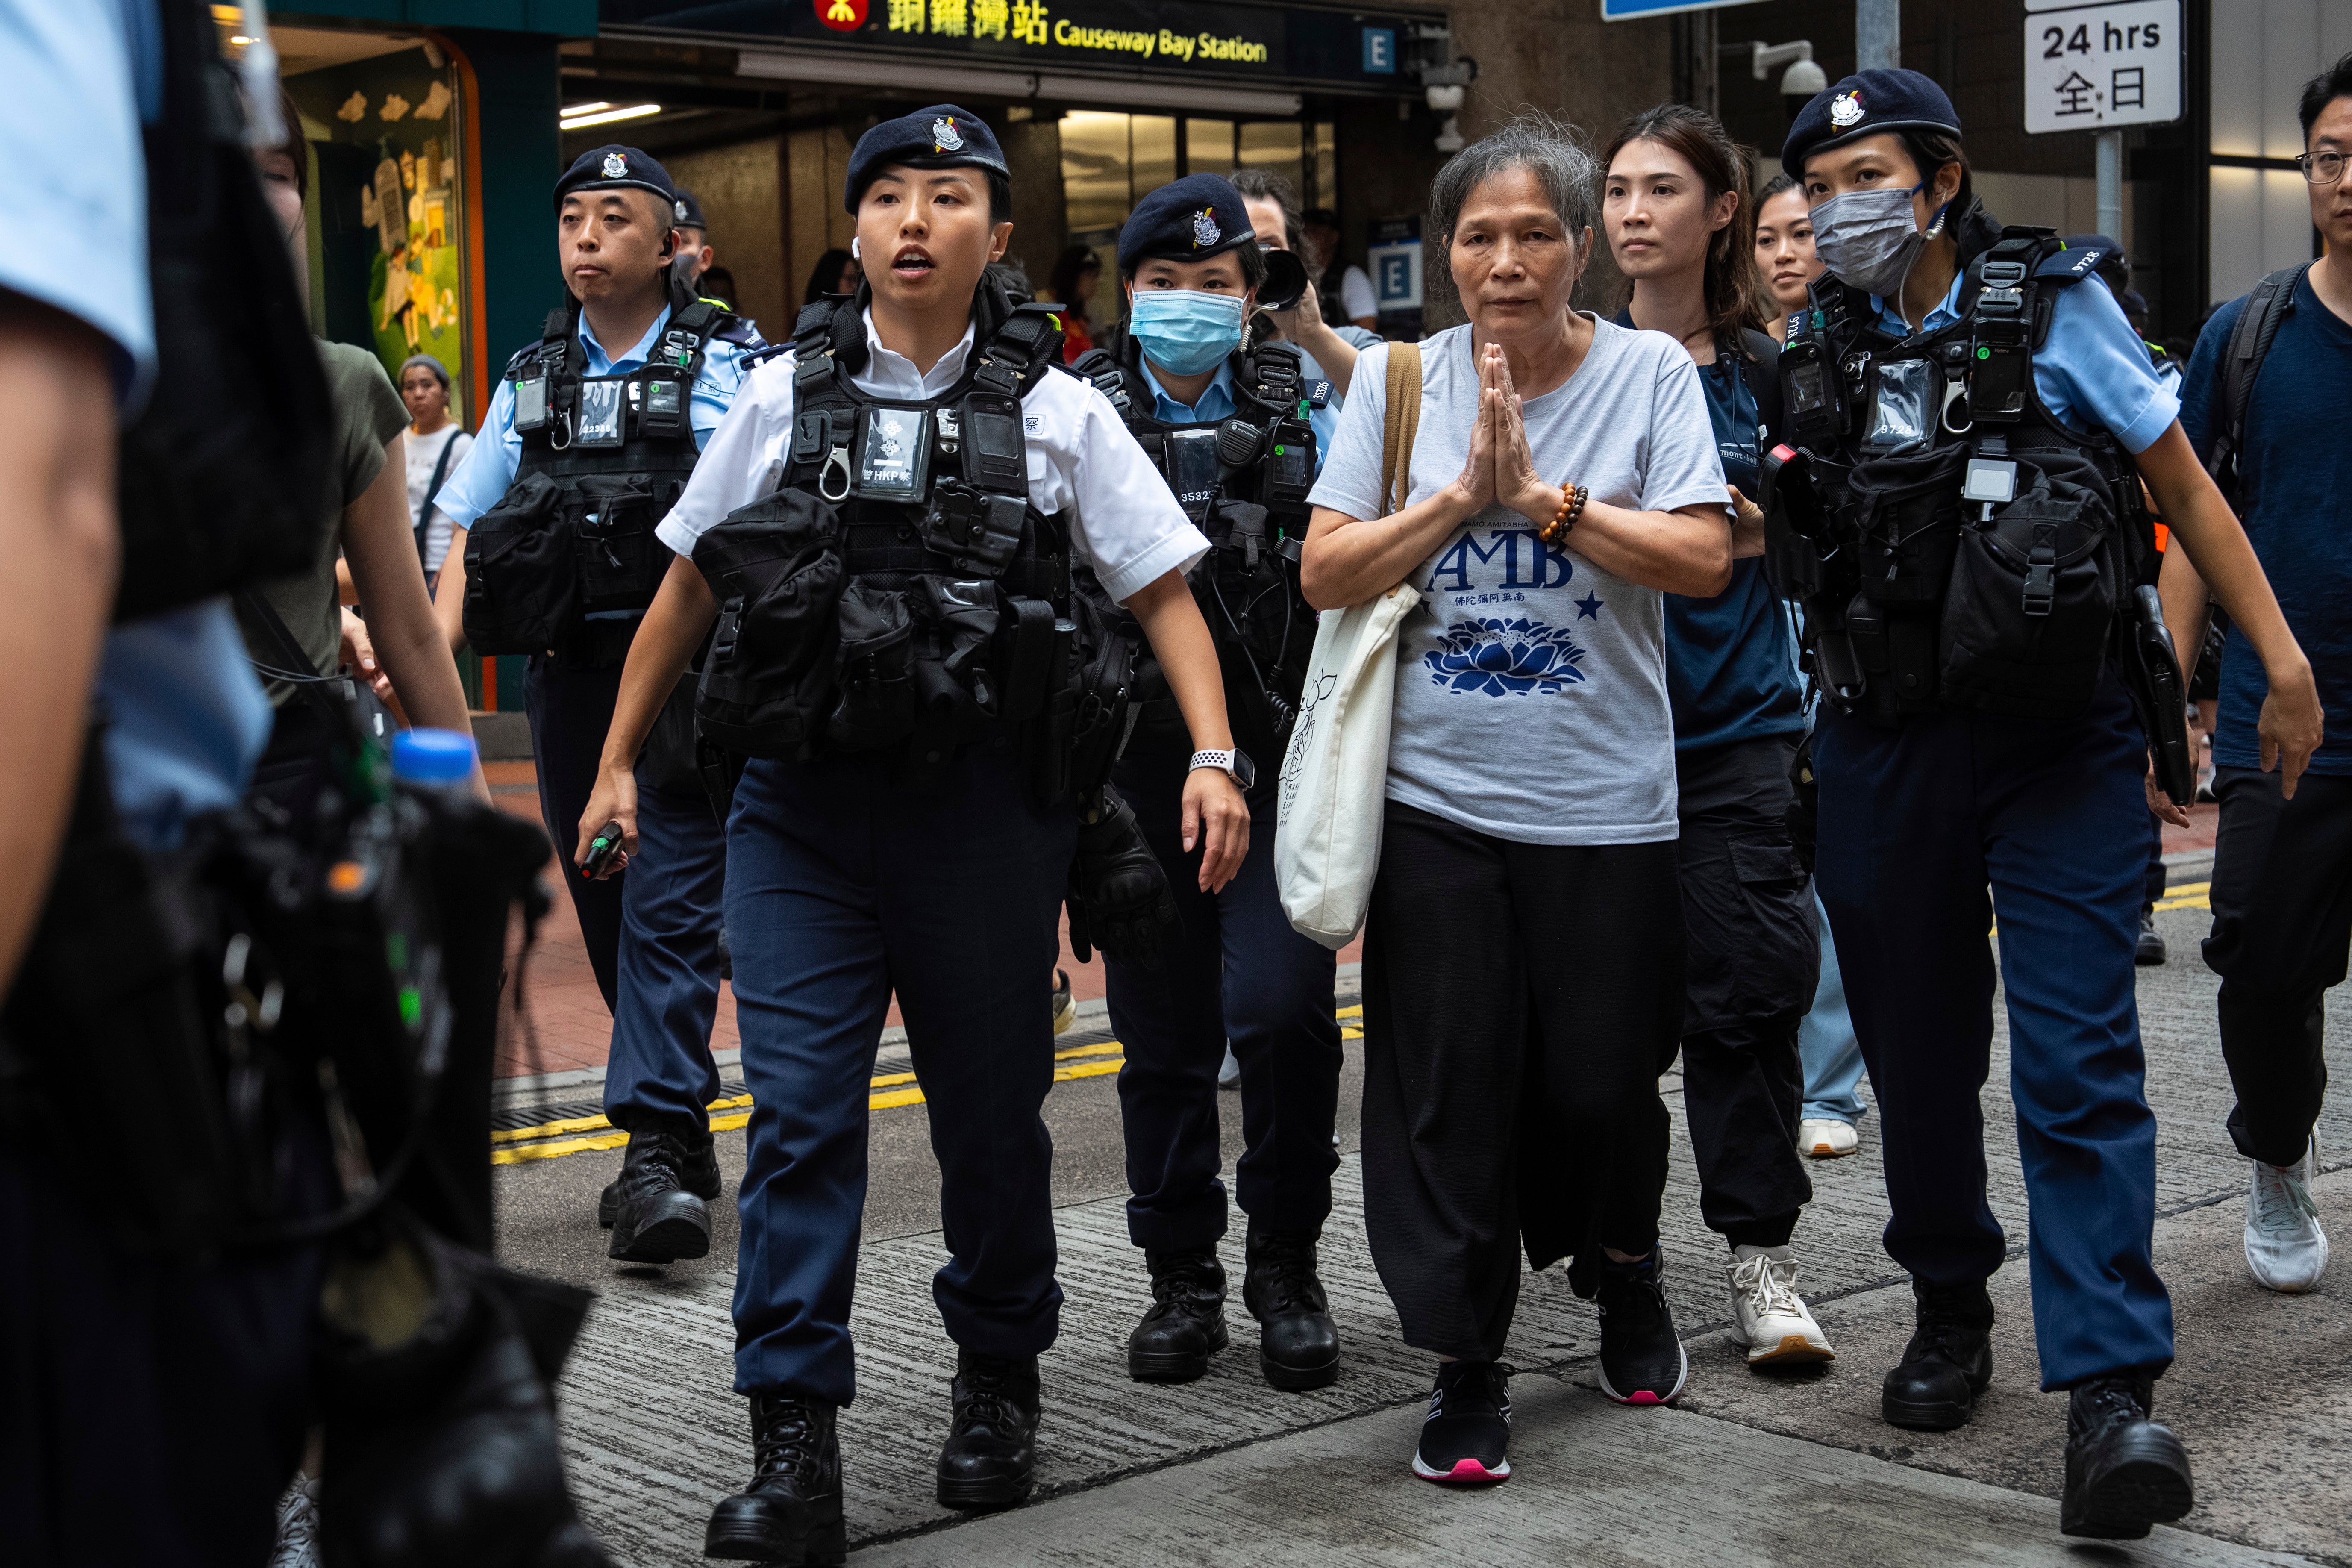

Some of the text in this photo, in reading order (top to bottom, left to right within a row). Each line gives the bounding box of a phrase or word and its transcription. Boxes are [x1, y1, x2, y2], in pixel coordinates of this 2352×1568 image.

[1054, 19, 1267, 62] Causeway Bay Station
[1371, 35, 1387, 66] E
[2043, 21, 2160, 59] 24 hrs
[2055, 66, 2144, 116] 全日
[2071, 251, 2100, 272] 9728
[1388, 261, 1403, 294] E
[1788, 316, 1799, 339] 9728
[1313, 382, 1329, 400] 35326
[582, 424, 611, 433] 22388
[1025, 417, 1038, 430] 察
[1238, 428, 1256, 438] MOTOROLA
[1881, 424, 1912, 435] 9728
[1181, 491, 1211, 502] 3532
